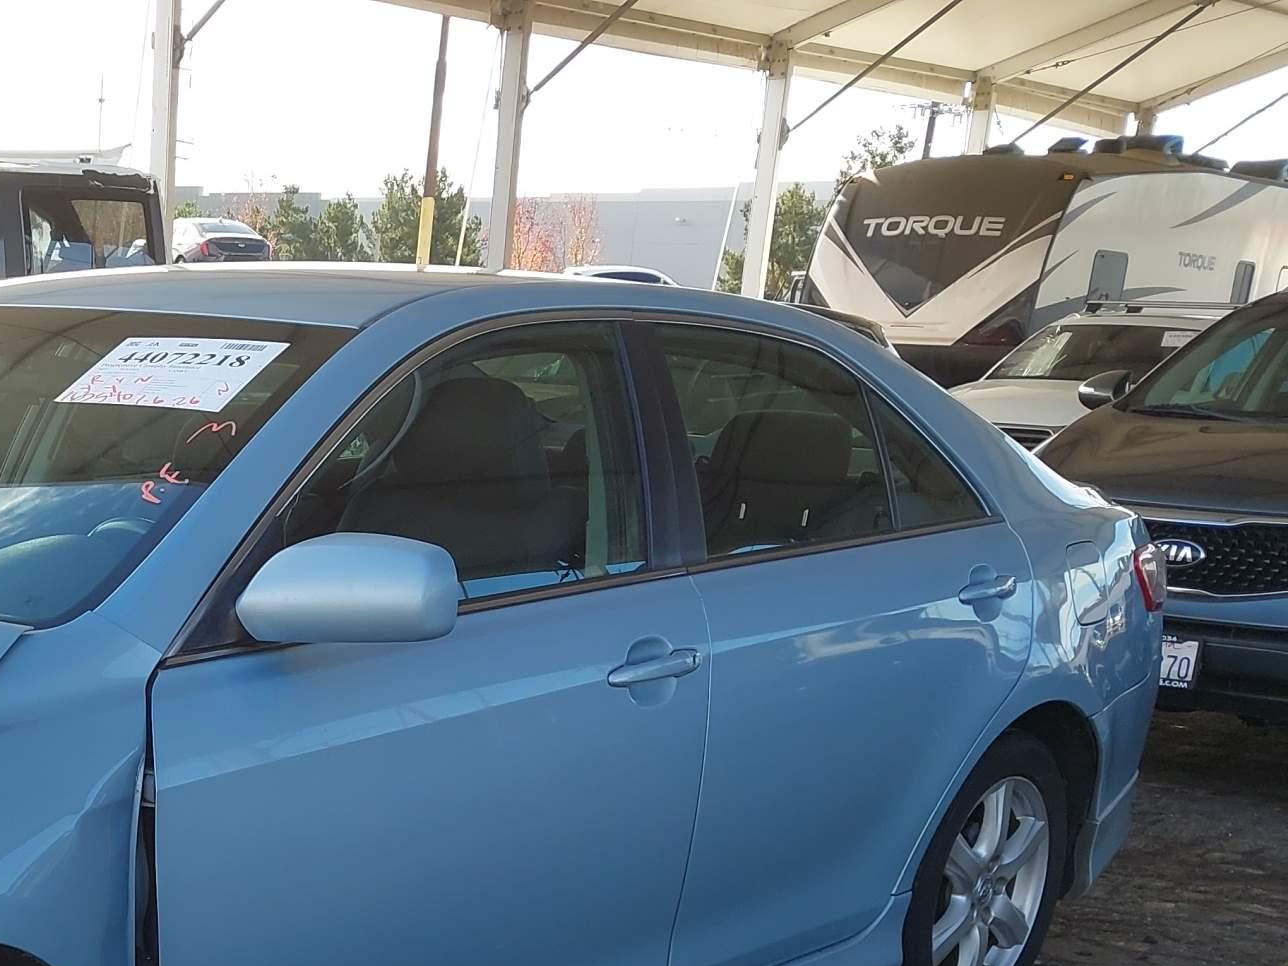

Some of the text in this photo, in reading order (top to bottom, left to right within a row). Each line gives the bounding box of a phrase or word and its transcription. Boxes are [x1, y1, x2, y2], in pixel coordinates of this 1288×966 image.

[863, 214, 1006, 238] TORQUE
[1178, 251, 1216, 271] TORQUE
[118, 351, 251, 368] 44072218
[1161, 654, 1191, 679] 70
